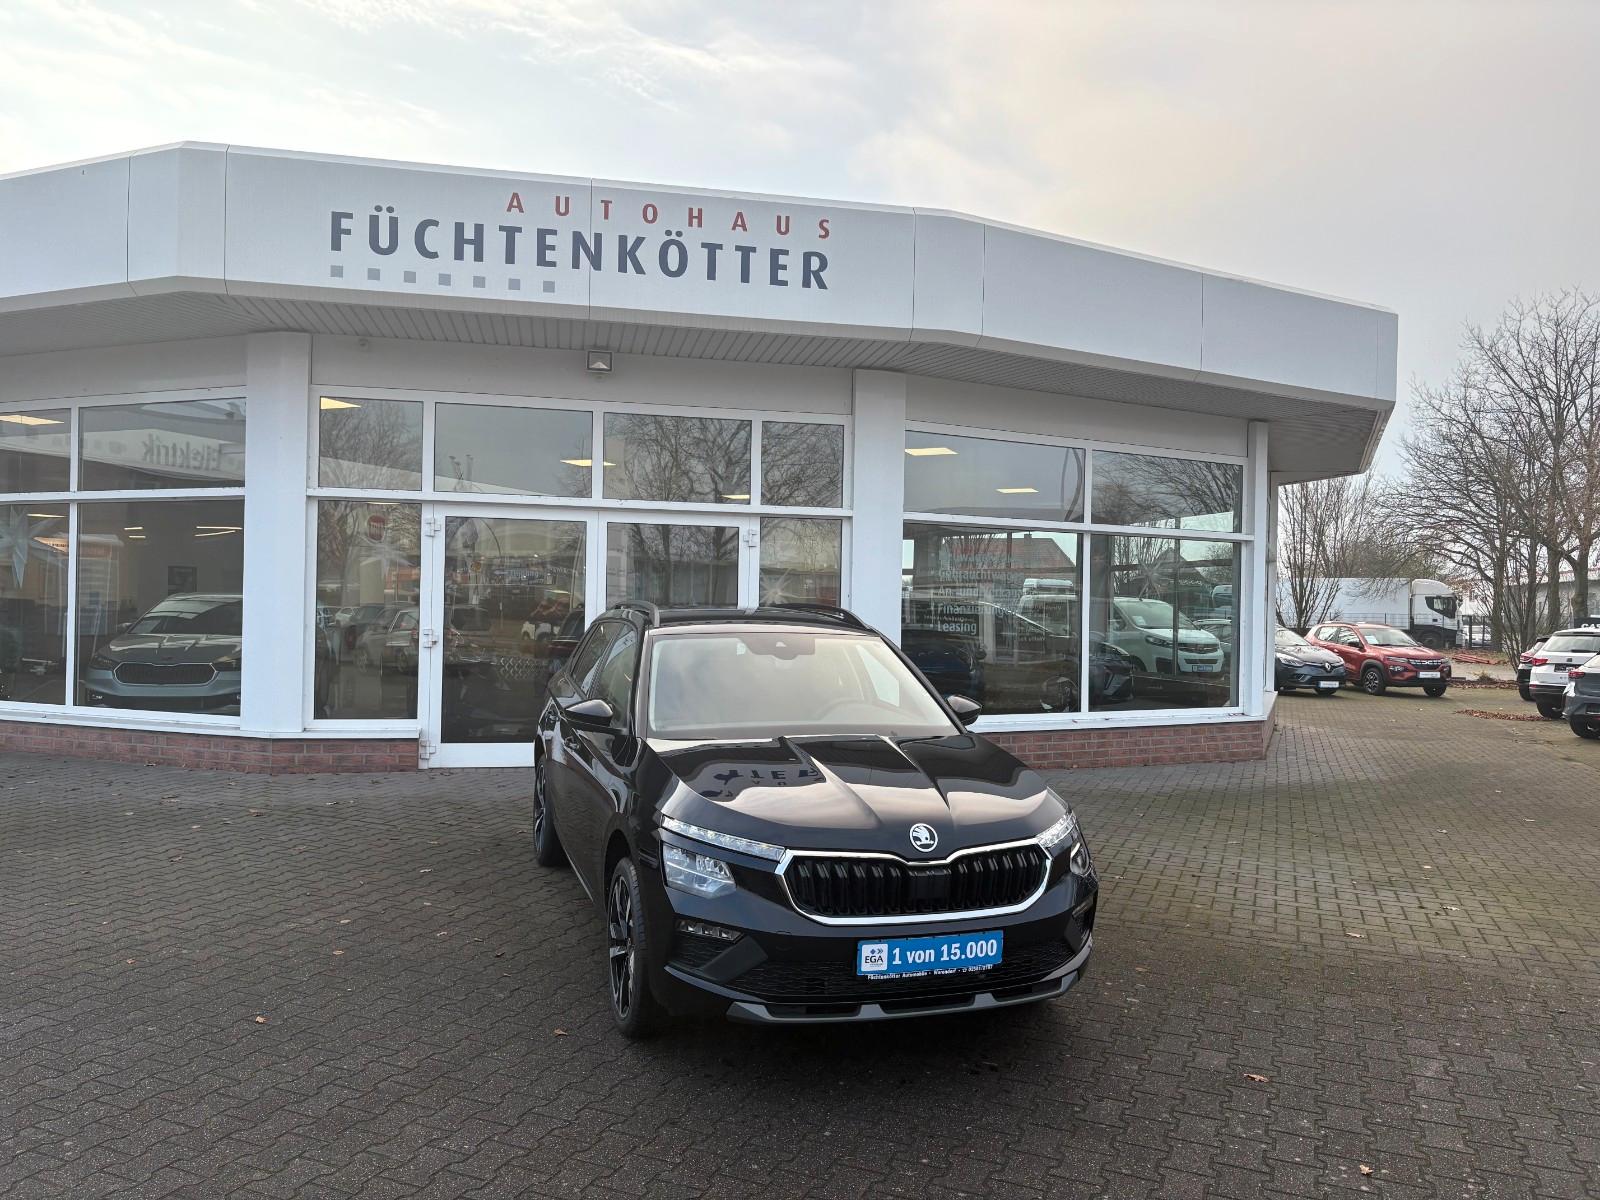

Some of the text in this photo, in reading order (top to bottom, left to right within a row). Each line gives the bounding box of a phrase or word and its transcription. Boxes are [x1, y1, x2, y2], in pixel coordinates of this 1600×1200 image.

[506, 192, 830, 239] AUTOHAUS
[330, 204, 829, 290] FÜCHTENKÖTTER
[937, 621, 977, 635] Leasing
[865, 955, 884, 964] EGA
[892, 939, 997, 965] 1 von 15.000
